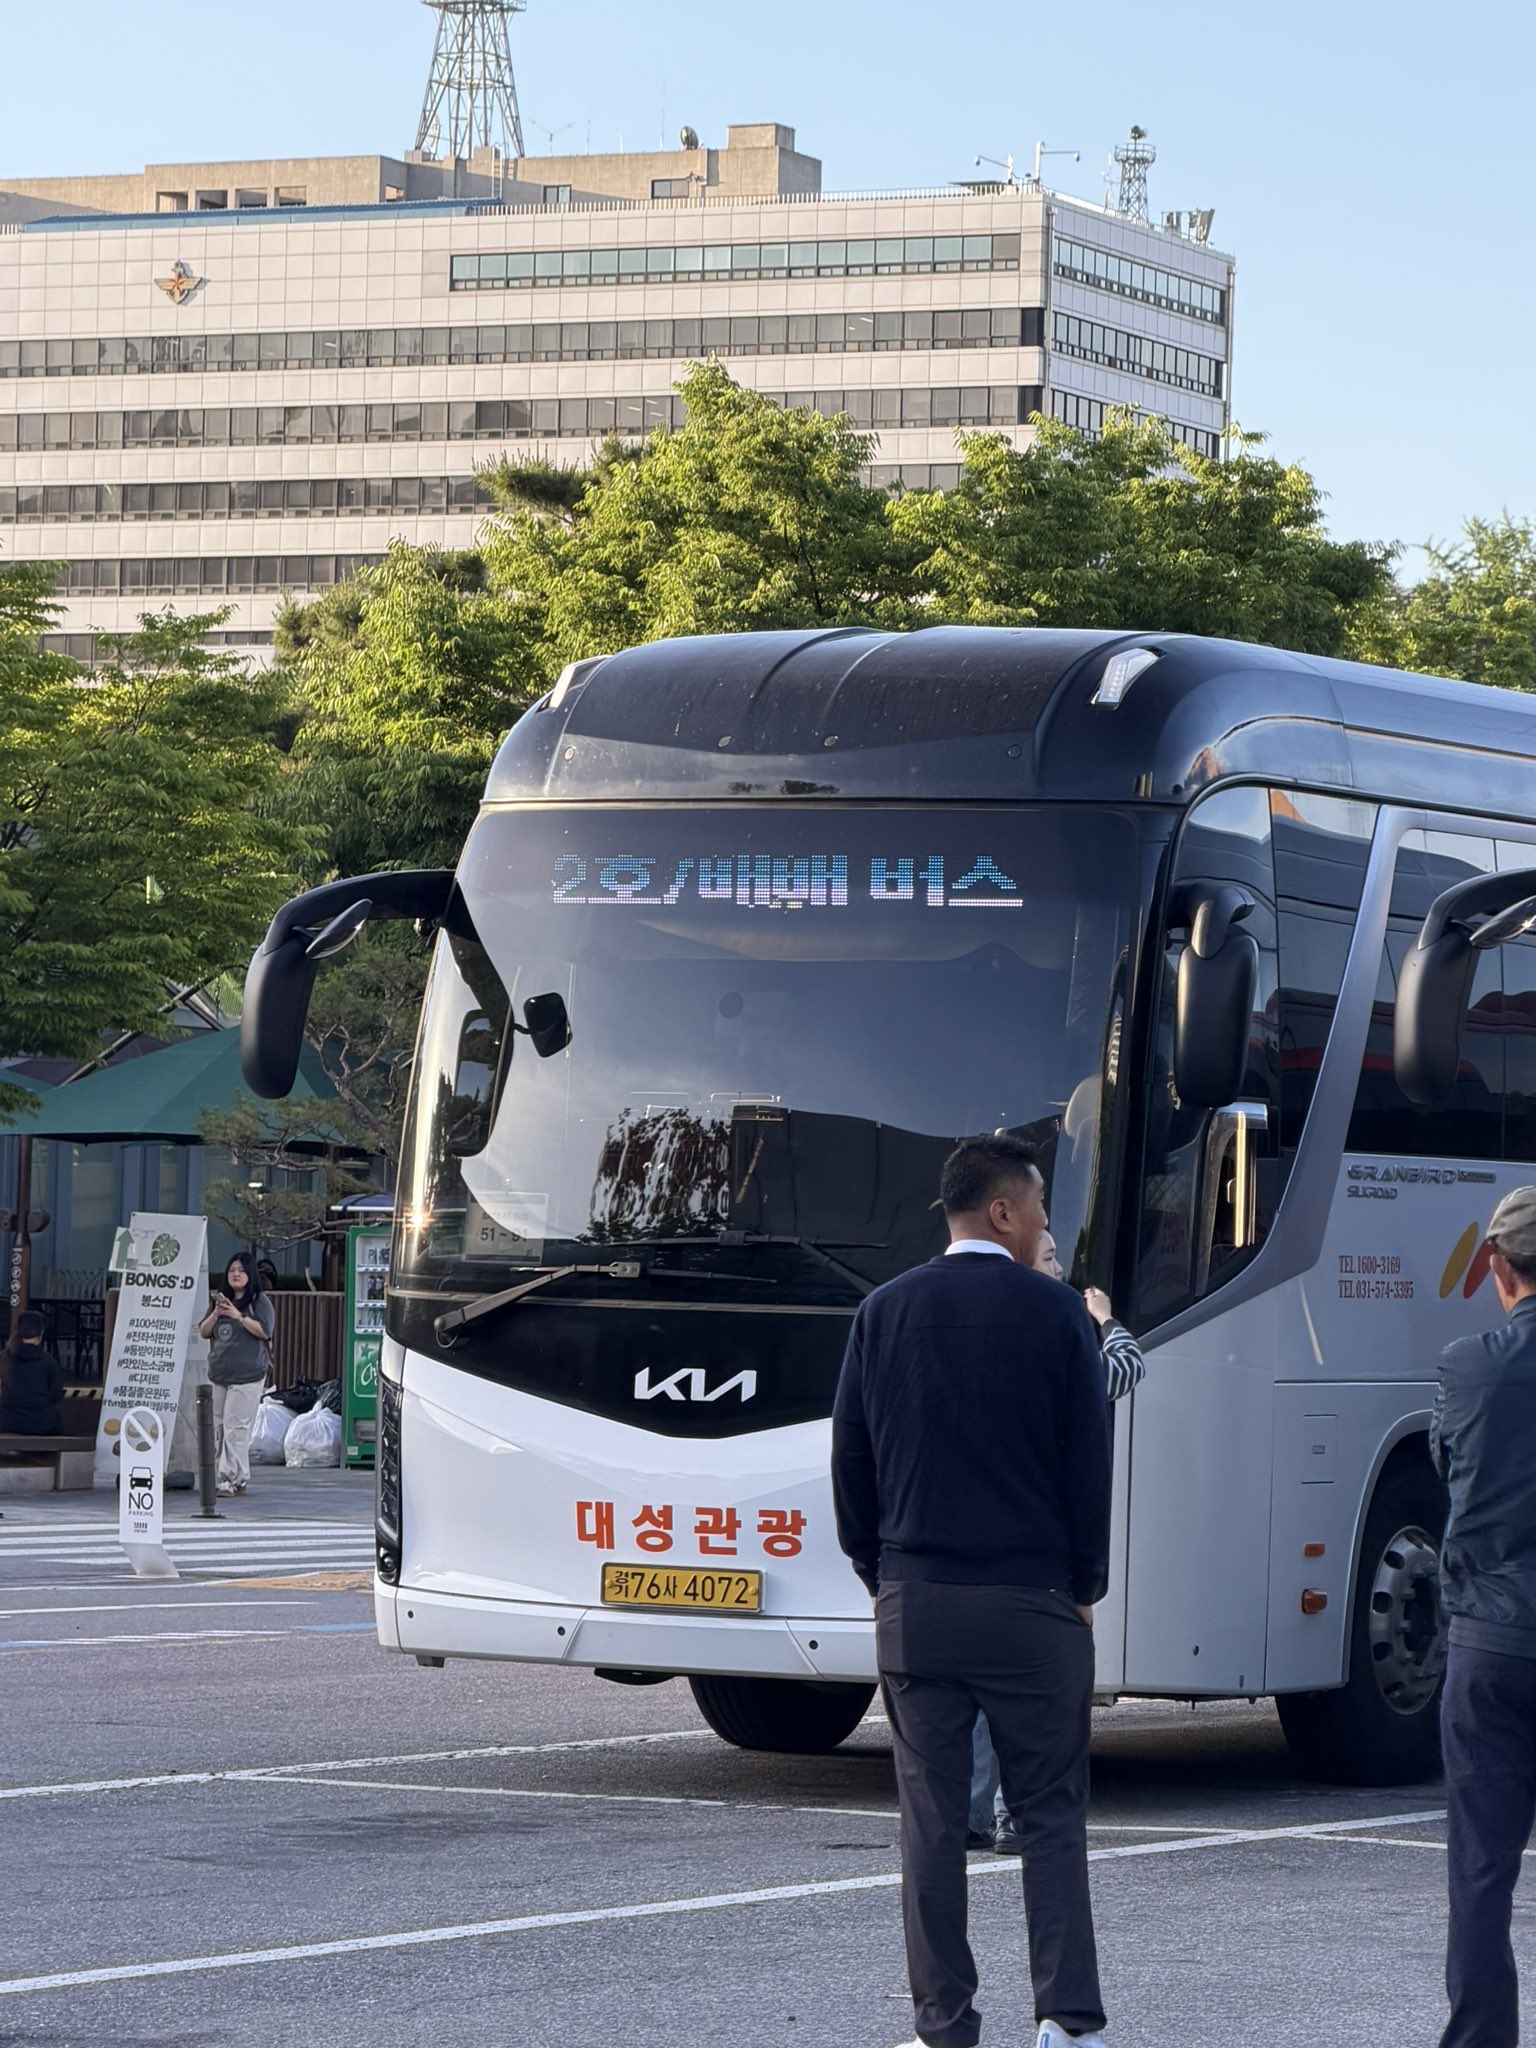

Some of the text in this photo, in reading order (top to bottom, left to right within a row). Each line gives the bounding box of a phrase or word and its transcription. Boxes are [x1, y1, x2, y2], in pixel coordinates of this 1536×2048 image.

[870, 856, 1023, 906] 버스
[1348, 1164, 1456, 1184] GRANBIRD
[1339, 1255, 1401, 1274] TEL 1600-3169
[1339, 1280, 1356, 1299] TEL
[141, 1294, 172, 1309] 봉스디
[123, 1345, 174, 1358] #등받이좌석
[117, 1358, 175, 1373] #맛있는소금빵
[128, 1373, 160, 1385] #디저트
[634, 1366, 757, 1403] KIA
[128, 1492, 154, 1510] NO
[684, 1575, 748, 1604] 4072
